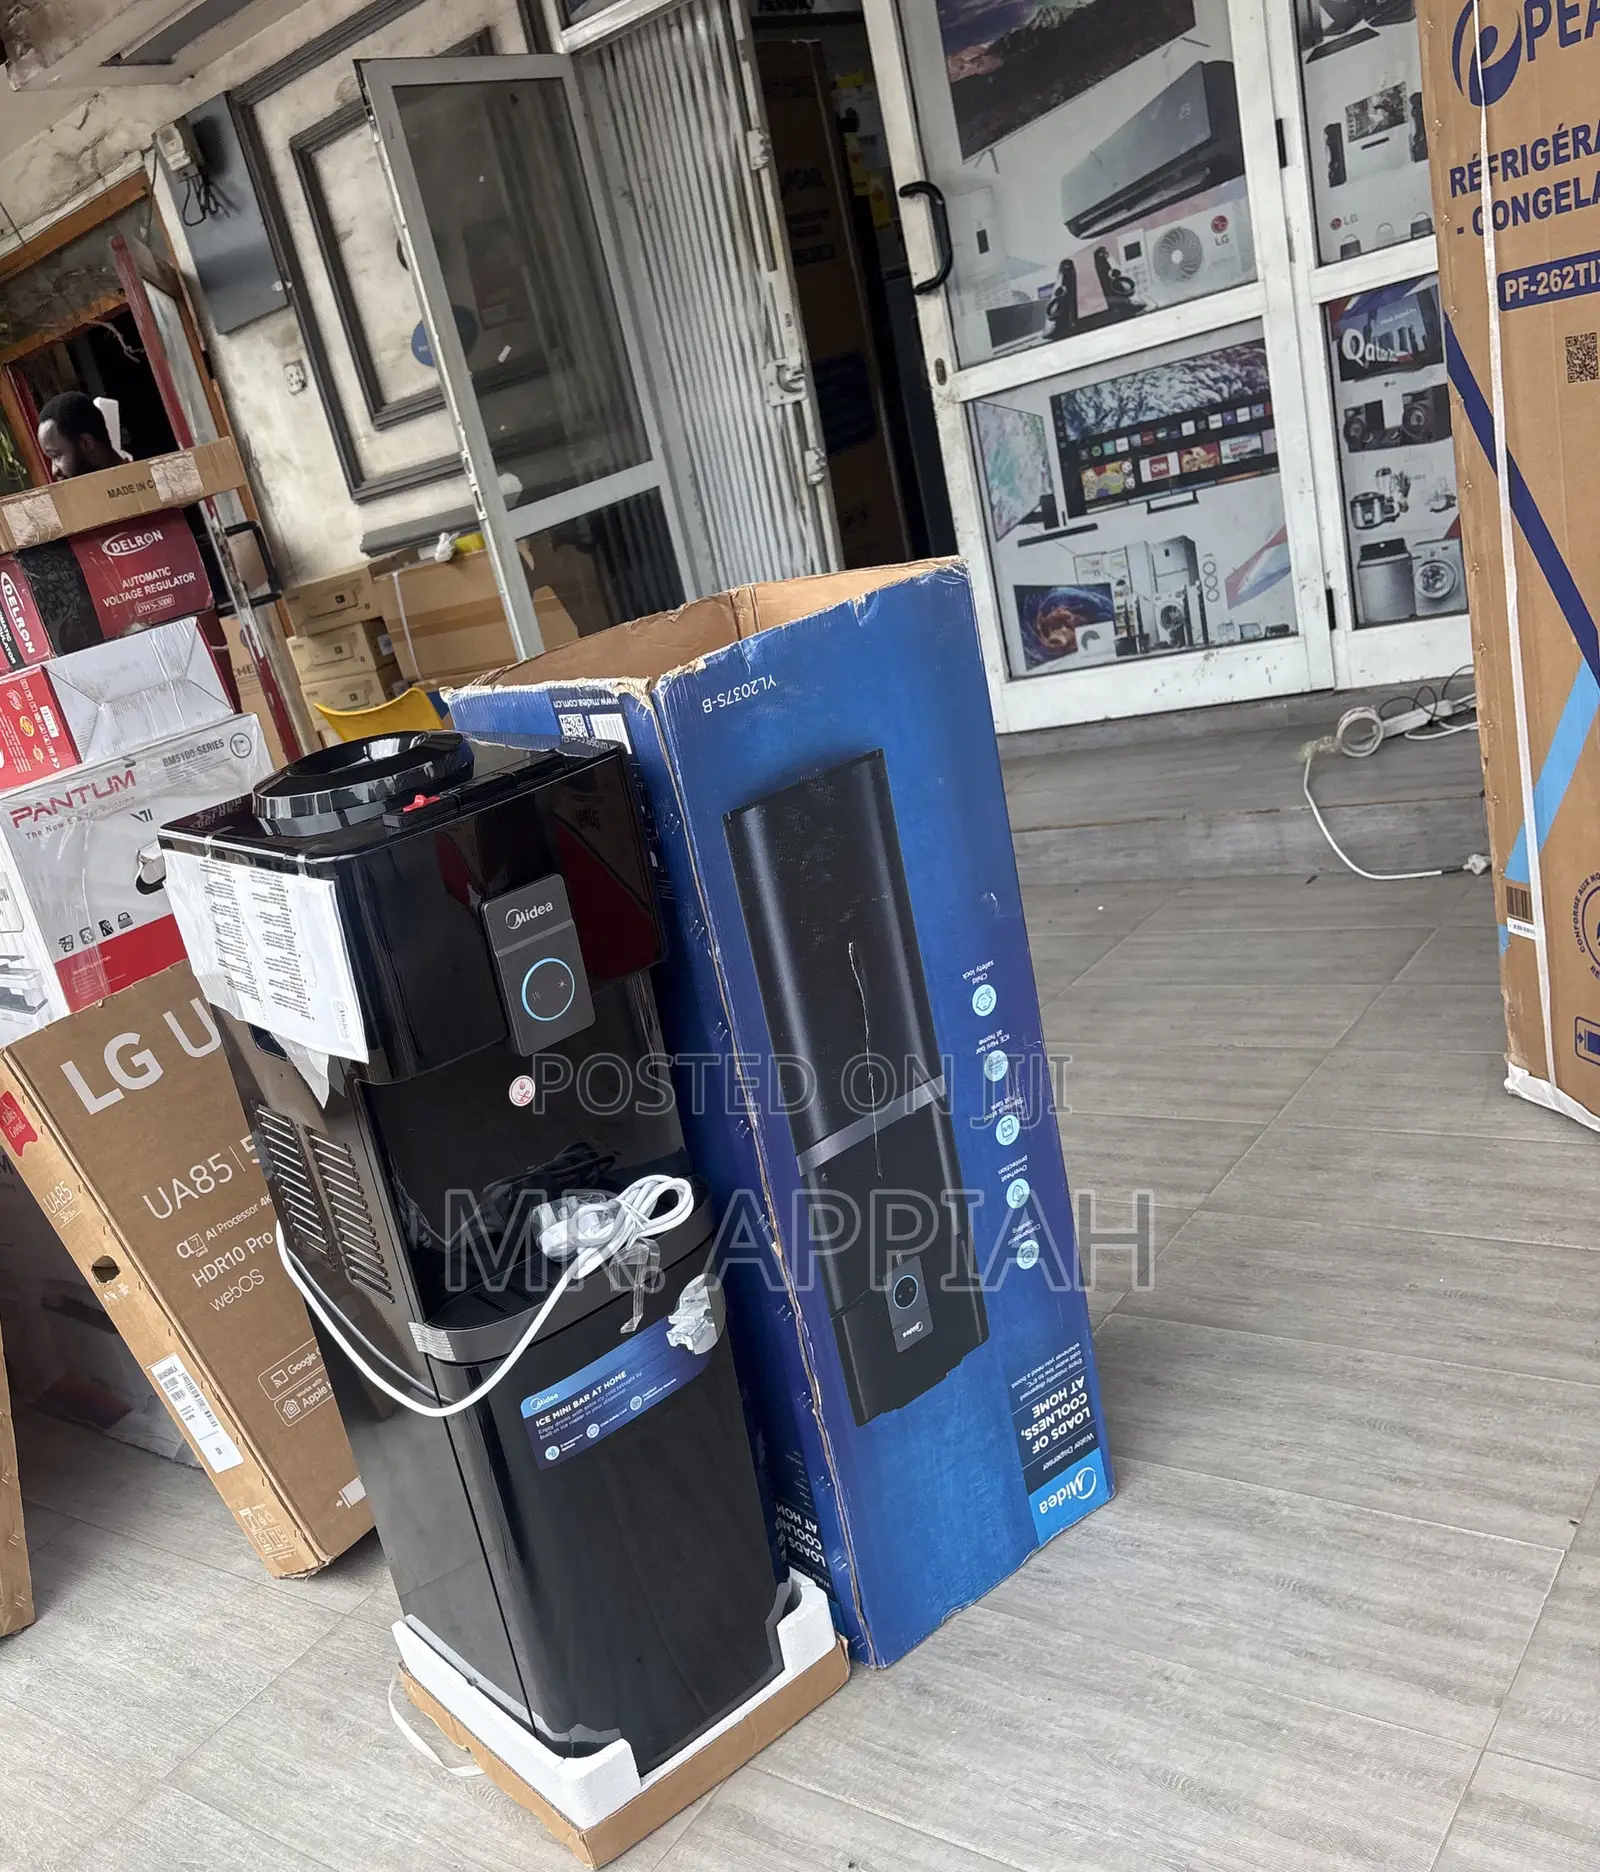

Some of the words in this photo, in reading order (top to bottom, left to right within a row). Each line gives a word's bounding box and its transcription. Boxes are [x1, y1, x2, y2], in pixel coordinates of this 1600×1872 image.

[1343, 213, 1359, 226] LG
[1214, 233, 1230, 247] LG
[1505, 258, 1600, 303] PF-262TI
[107, 484, 136, 499] MADE
[136, 482, 146, 492] IN
[147, 479, 156, 489] C
[110, 530, 163, 553] DELRON
[122, 566, 171, 589] AUTOMATIC
[102, 587, 143, 608] VOLTAGE
[144, 572, 196, 596] REGULATOR
[5, 584, 36, 654] DELRON
[702, 674, 777, 713] YL2037S-B
[196, 738, 225, 755] SERIES
[10, 770, 137, 829] PANTUM
[25, 829, 43, 840] The
[1577, 878, 1591, 897] AUX
[505, 901, 554, 930] Midea
[1572, 895, 1586, 954] CONFORME
[962, 969, 976, 980] lock
[976, 959, 994, 973] safety
[971, 972, 988, 985] Child
[975, 1045, 986, 1055] bar
[978, 1033, 996, 1045] home
[1000, 1033, 1011, 1044] ICE
[60, 1032, 164, 1115] LG
[998, 1154, 1028, 1175] protection
[1001, 1164, 1028, 1182] Overheat
[142, 1152, 233, 1219] UA85
[42, 1181, 73, 1214] UA85
[205, 1227, 218, 1241] AI
[216, 1203, 259, 1233] Processor
[260, 1193, 273, 1206] 4K
[192, 1246, 246, 1288] HDR10
[245, 1231, 274, 1255] Pro
[209, 1268, 265, 1312] webOS
[287, 1352, 317, 1375] Google
[1055, 1357, 1070, 1369] water
[1069, 1350, 1082, 1361] cold
[1020, 1380, 1046, 1402] dispensed
[1070, 1375, 1085, 1395] AT
[302, 1386, 328, 1408] Apple
[530, 1393, 559, 1410] Midea
[535, 1415, 552, 1428] ICE
[552, 1404, 572, 1420] MINI
[572, 1393, 591, 1408] BAR
[592, 1385, 602, 1398] AT
[603, 1370, 627, 1390] HOME
[1031, 1387, 1068, 1419] HOME
[538, 1425, 554, 1435] Enjoy
[554, 1415, 571, 1427] drinks
[571, 1408, 584, 1418] with
[584, 1400, 597, 1411] extra
[1020, 1392, 1088, 1441] COOLNESS,
[1051, 1406, 1091, 1441] LOADS
[1031, 1435, 1049, 1455] OF
[1073, 1432, 1095, 1450] Water
[1042, 1445, 1074, 1471] Dispenser
[1038, 1466, 1097, 1514] Midea
[805, 1519, 818, 1534] AT
[788, 1536, 826, 1567] LOADS
